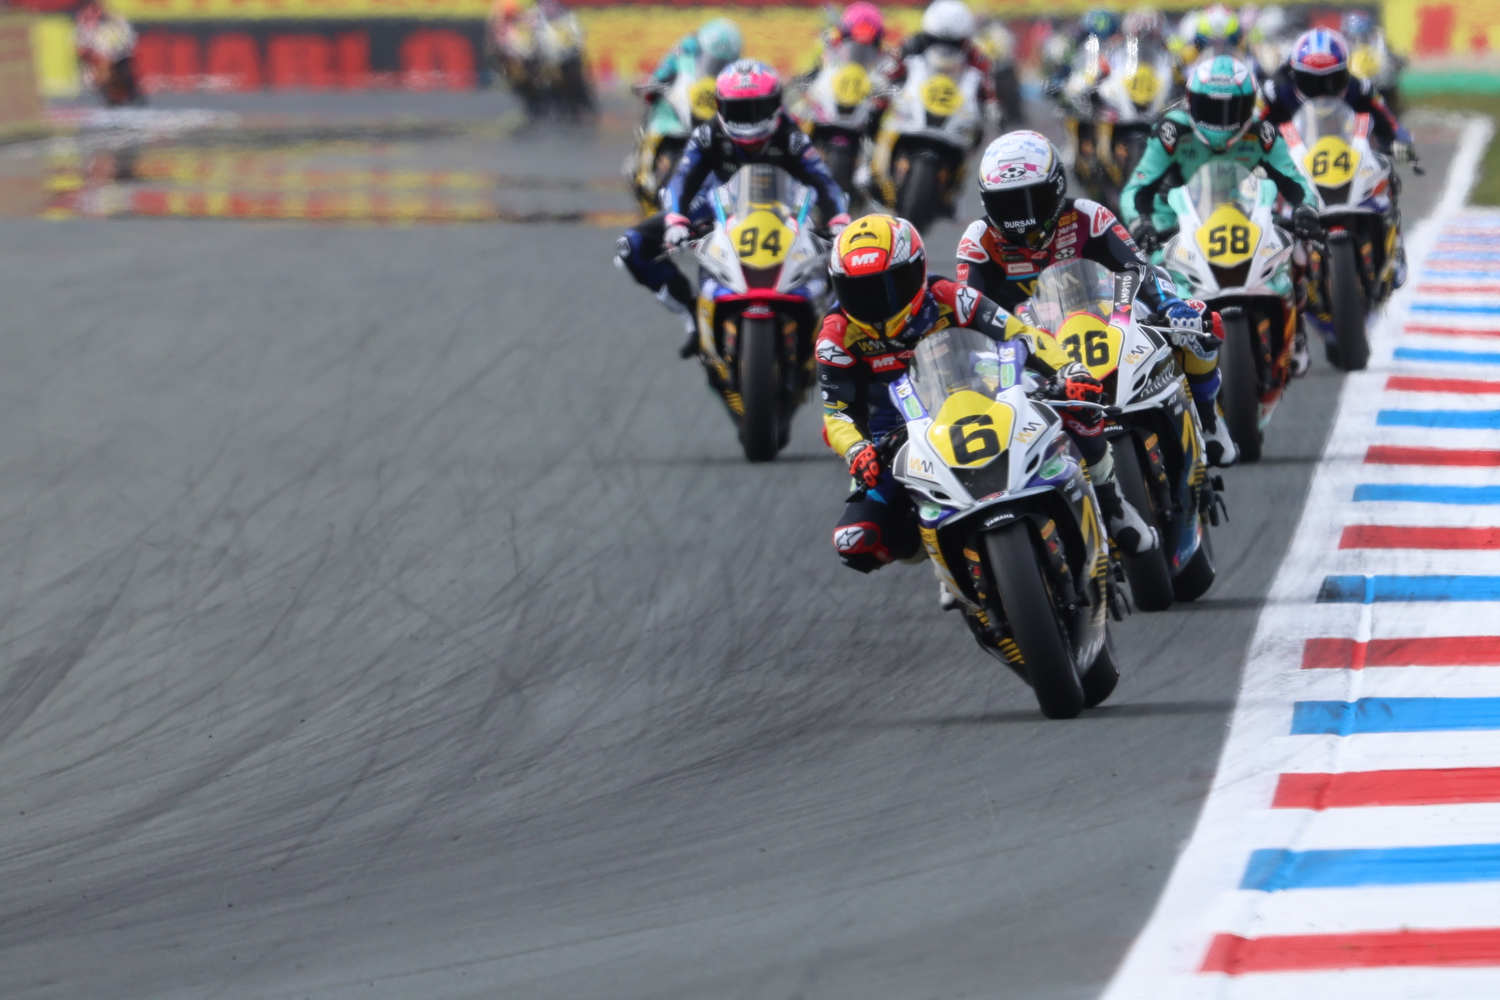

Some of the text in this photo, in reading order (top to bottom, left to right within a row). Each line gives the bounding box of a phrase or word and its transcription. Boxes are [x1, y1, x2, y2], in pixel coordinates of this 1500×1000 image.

[1312, 151, 1350, 177] 64
[739, 227, 782, 257] 94
[1208, 225, 1249, 257] 58
[851, 252, 879, 266] MT
[1062, 330, 1110, 367] 36
[949, 414, 1000, 465] 6
